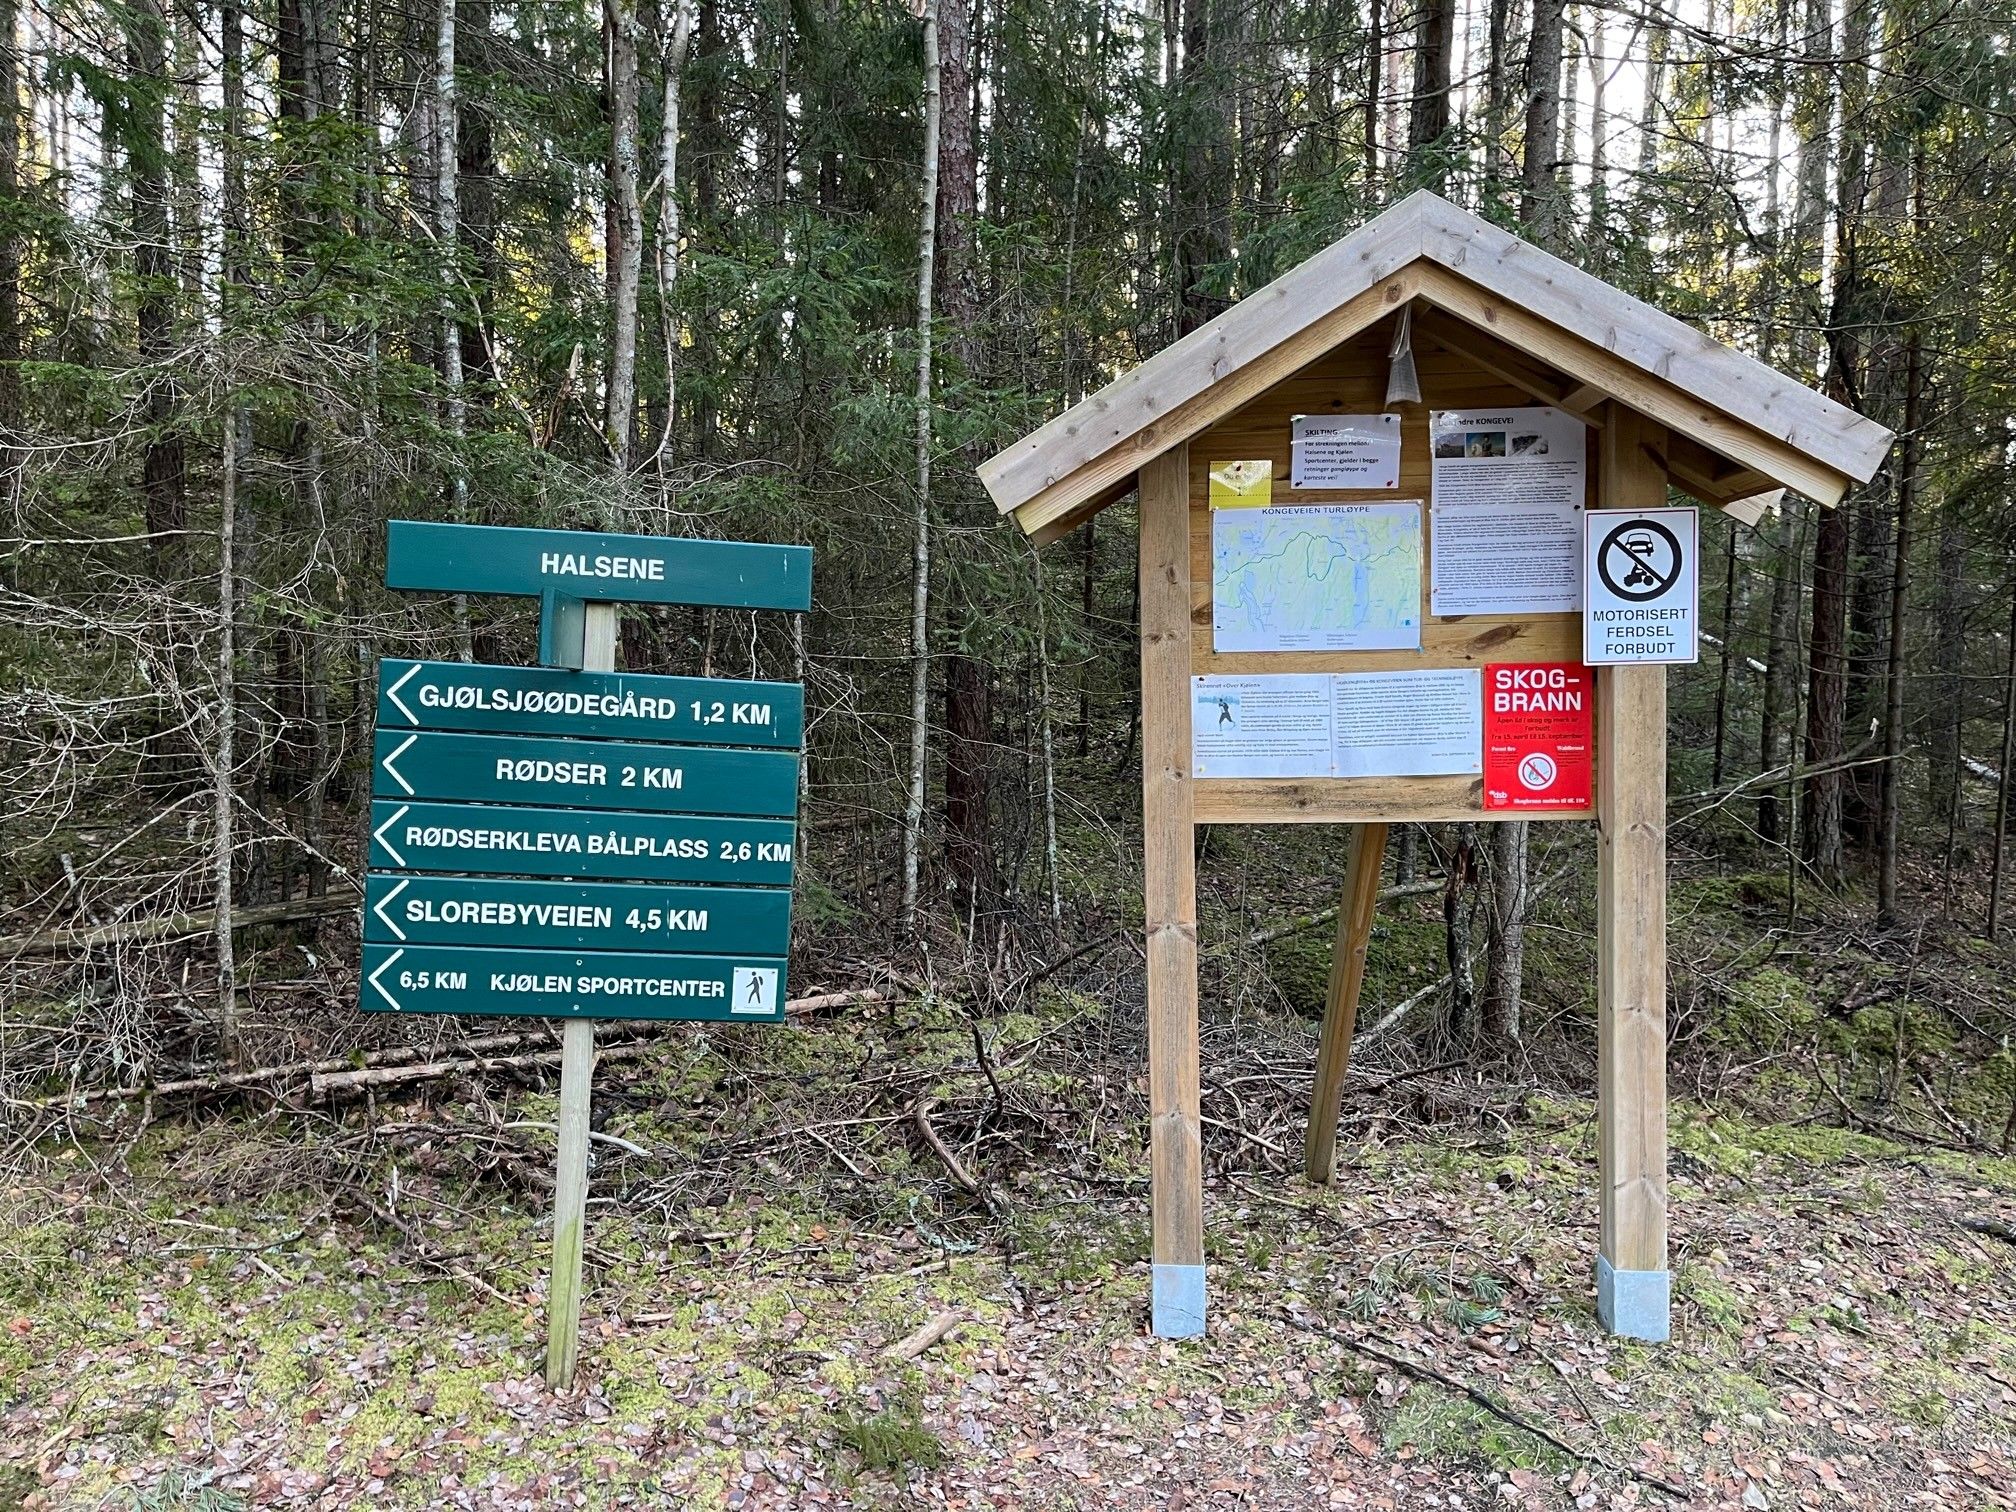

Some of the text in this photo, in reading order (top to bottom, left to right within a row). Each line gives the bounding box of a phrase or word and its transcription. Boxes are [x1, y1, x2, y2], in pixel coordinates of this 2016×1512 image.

[1475, 416, 1514, 425] KONGEVEI
[1262, 505, 1371, 515] KONGEVEIEN TURLØYPE
[541, 553, 665, 581] HALSENE
[1593, 608, 1688, 621] MOTORISERT
[1607, 626, 1674, 638] FERDSEL
[1605, 642, 1676, 655] FORBUDT
[1495, 669, 1580, 690] SKOG-
[419, 684, 771, 726] GJØLSJØØDEGÅRD 1,2 KM
[1494, 691, 1582, 712] BRANN
[496, 758, 683, 789] RØDSER 2 KM
[406, 826, 792, 864] RØDSERKLEVA BÅLPLASS 2,6 KM
[406, 899, 708, 933] SLOREBYVEIEN 4,5 KM
[399, 970, 725, 999] 6,5 KM KJØLEN SPORTCENTER
